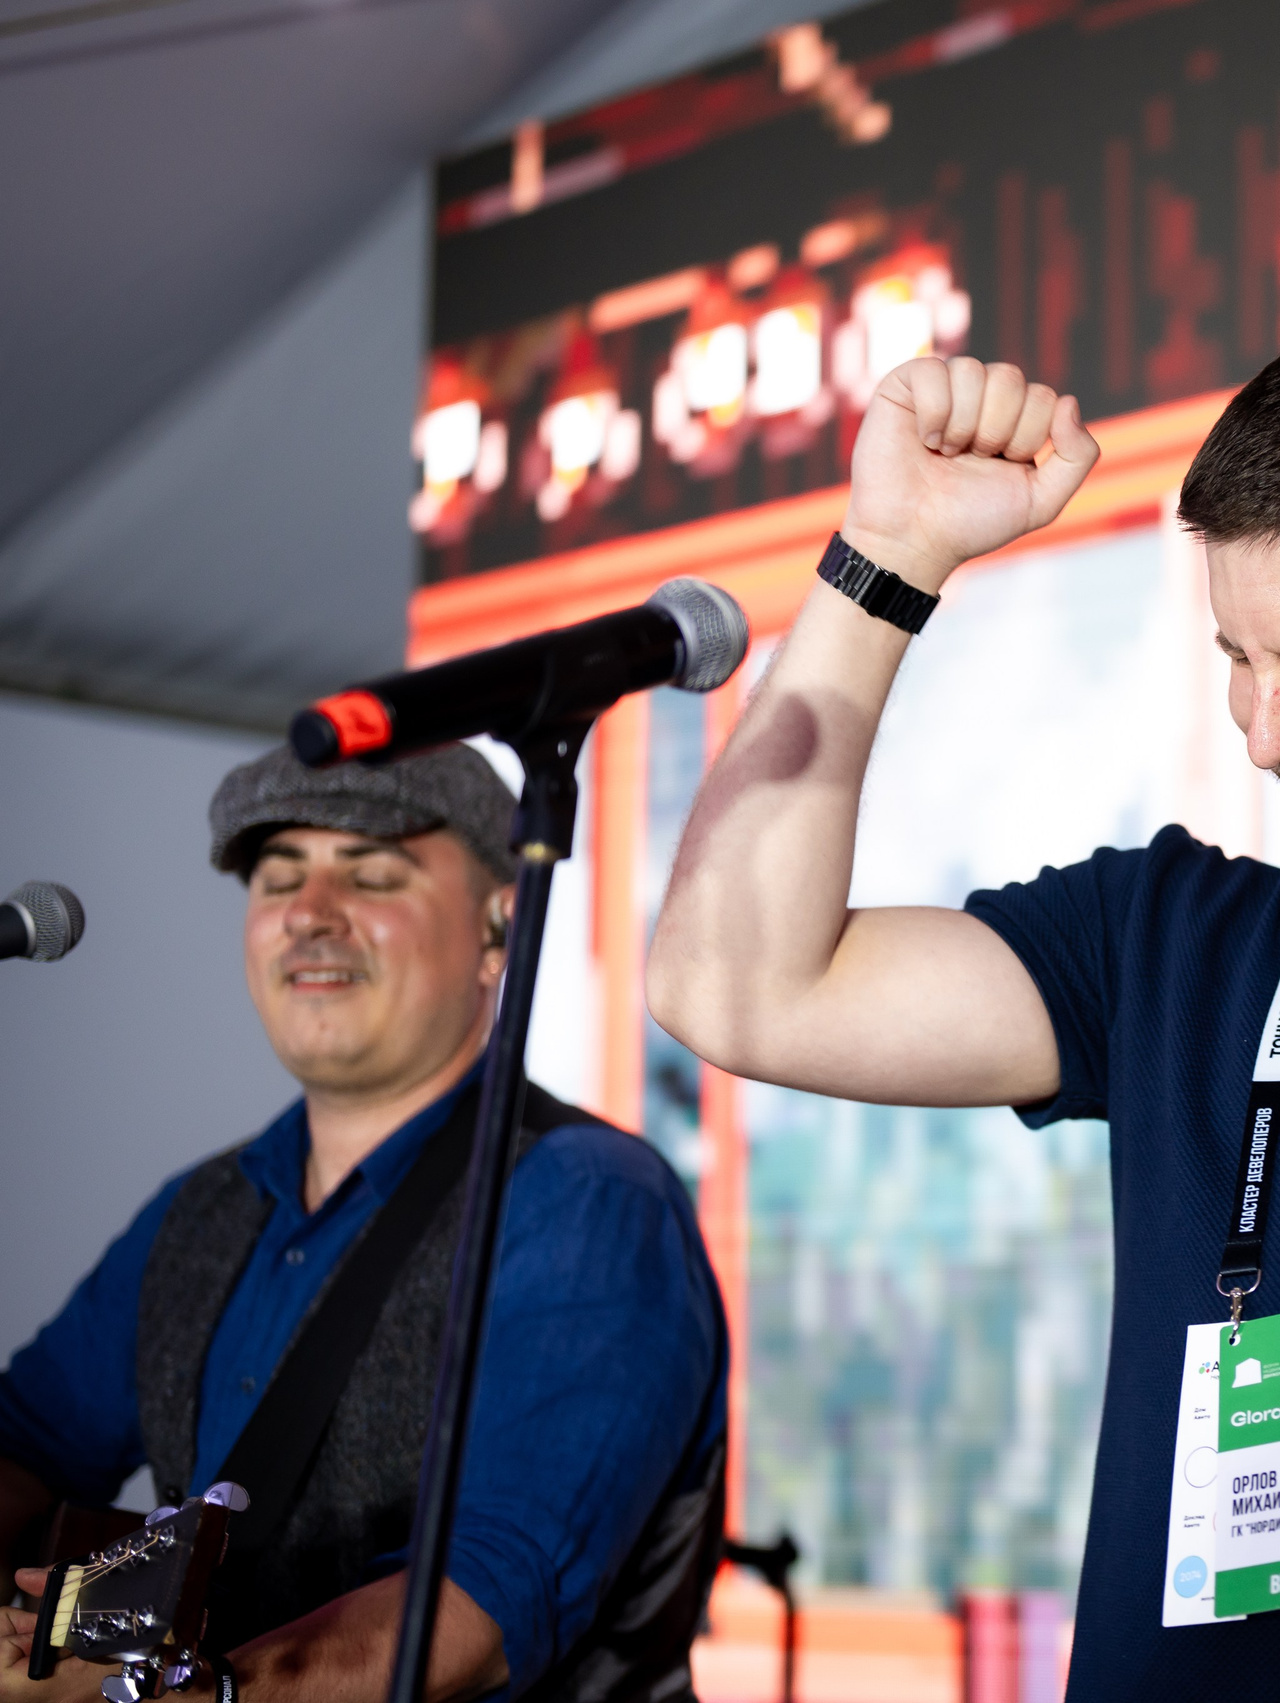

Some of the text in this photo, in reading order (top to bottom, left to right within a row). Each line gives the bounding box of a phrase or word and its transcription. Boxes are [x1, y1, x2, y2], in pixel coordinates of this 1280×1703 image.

[1239, 1107, 1273, 1233] КЛАСТЕР ДЕВЕЛОПЕРОВ
[1232, 1470, 1277, 1494] ОРЛОВ
[1231, 1524, 1244, 1538] ГК
